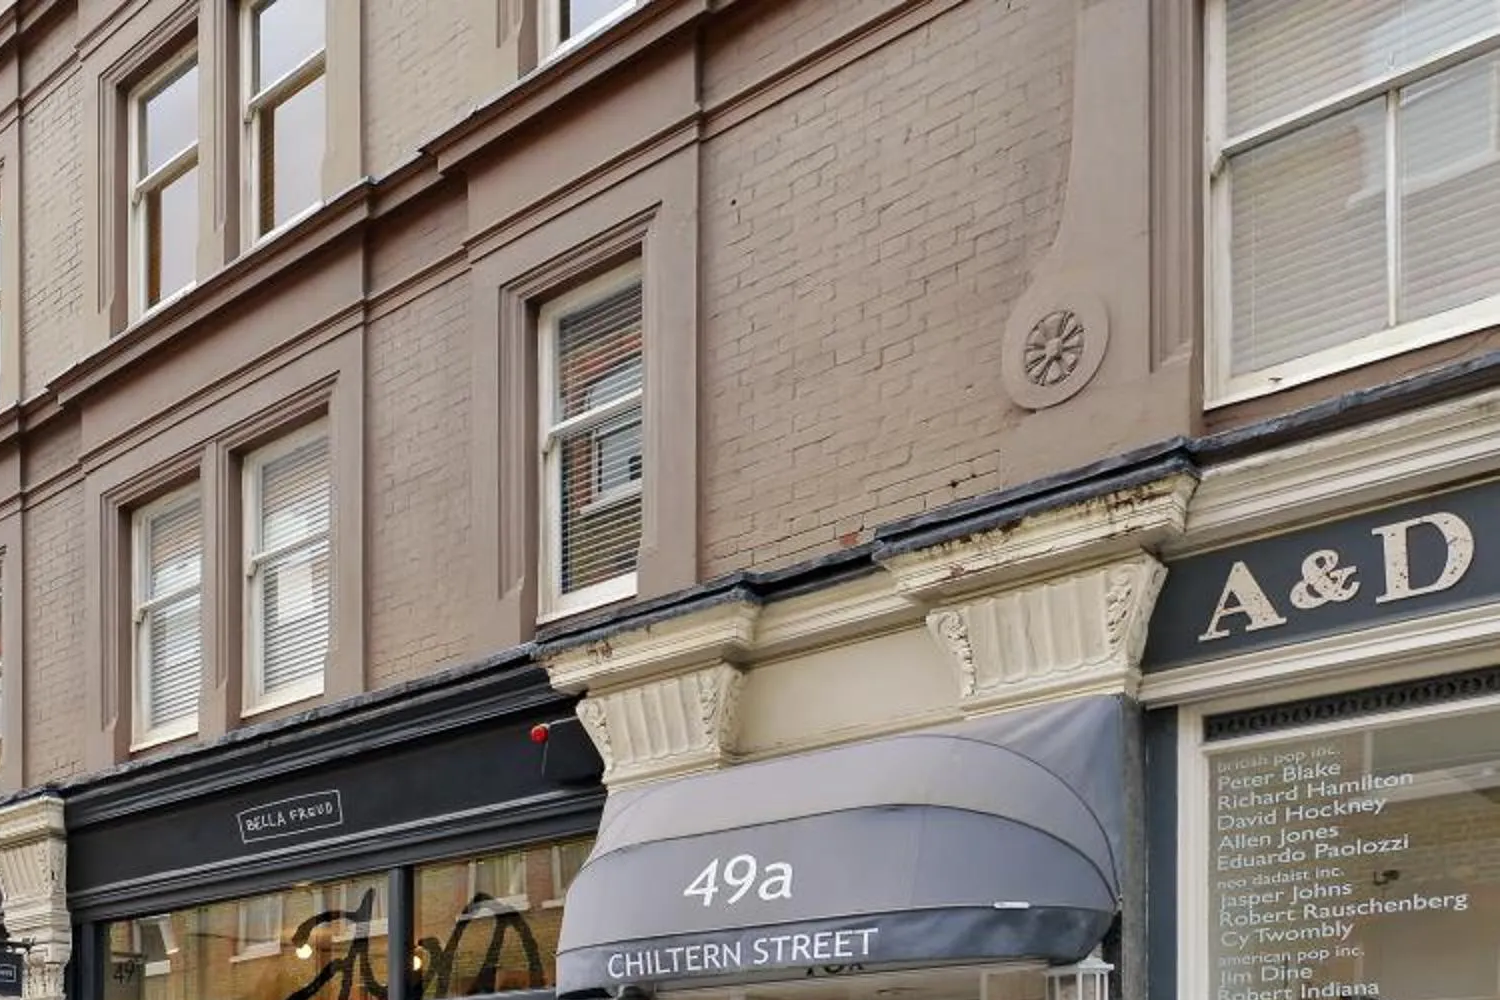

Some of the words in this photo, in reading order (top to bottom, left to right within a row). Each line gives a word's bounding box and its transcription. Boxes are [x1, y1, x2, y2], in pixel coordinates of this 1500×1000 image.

[1274, 751, 1306, 766] pop
[1218, 774, 1275, 791] Peter
[1282, 763, 1341, 782] Blake
[1218, 785, 1298, 811] Richard
[1307, 773, 1414, 799] Hamilton
[245, 811, 287, 832] BELLA
[289, 801, 333, 821] FREUD
[1217, 809, 1277, 831] David
[1285, 797, 1388, 823] Hockney
[1217, 848, 1306, 871] Eduardo
[1315, 833, 1409, 859] Paolozzi
[1219, 833, 1271, 850] Allen
[1278, 826, 1340, 848] Jones
[683, 853, 793, 907] 49a
[1252, 870, 1311, 886] dadaist
[1219, 908, 1297, 927] Robert
[1303, 892, 1469, 921] Rauschenberg
[1220, 890, 1285, 911] Jasper
[1290, 883, 1353, 905] Johns
[1220, 931, 1249, 950] Cy
[1254, 920, 1355, 944] Twombly
[607, 940, 742, 979] CHILTERN
[752, 927, 880, 966] STREET
[1218, 950, 1290, 966] american
[1297, 948, 1330, 963] pop
[1220, 971, 1252, 988] Jim
[1261, 965, 1313, 982] Dine
[1301, 981, 1379, 999] Indiana
